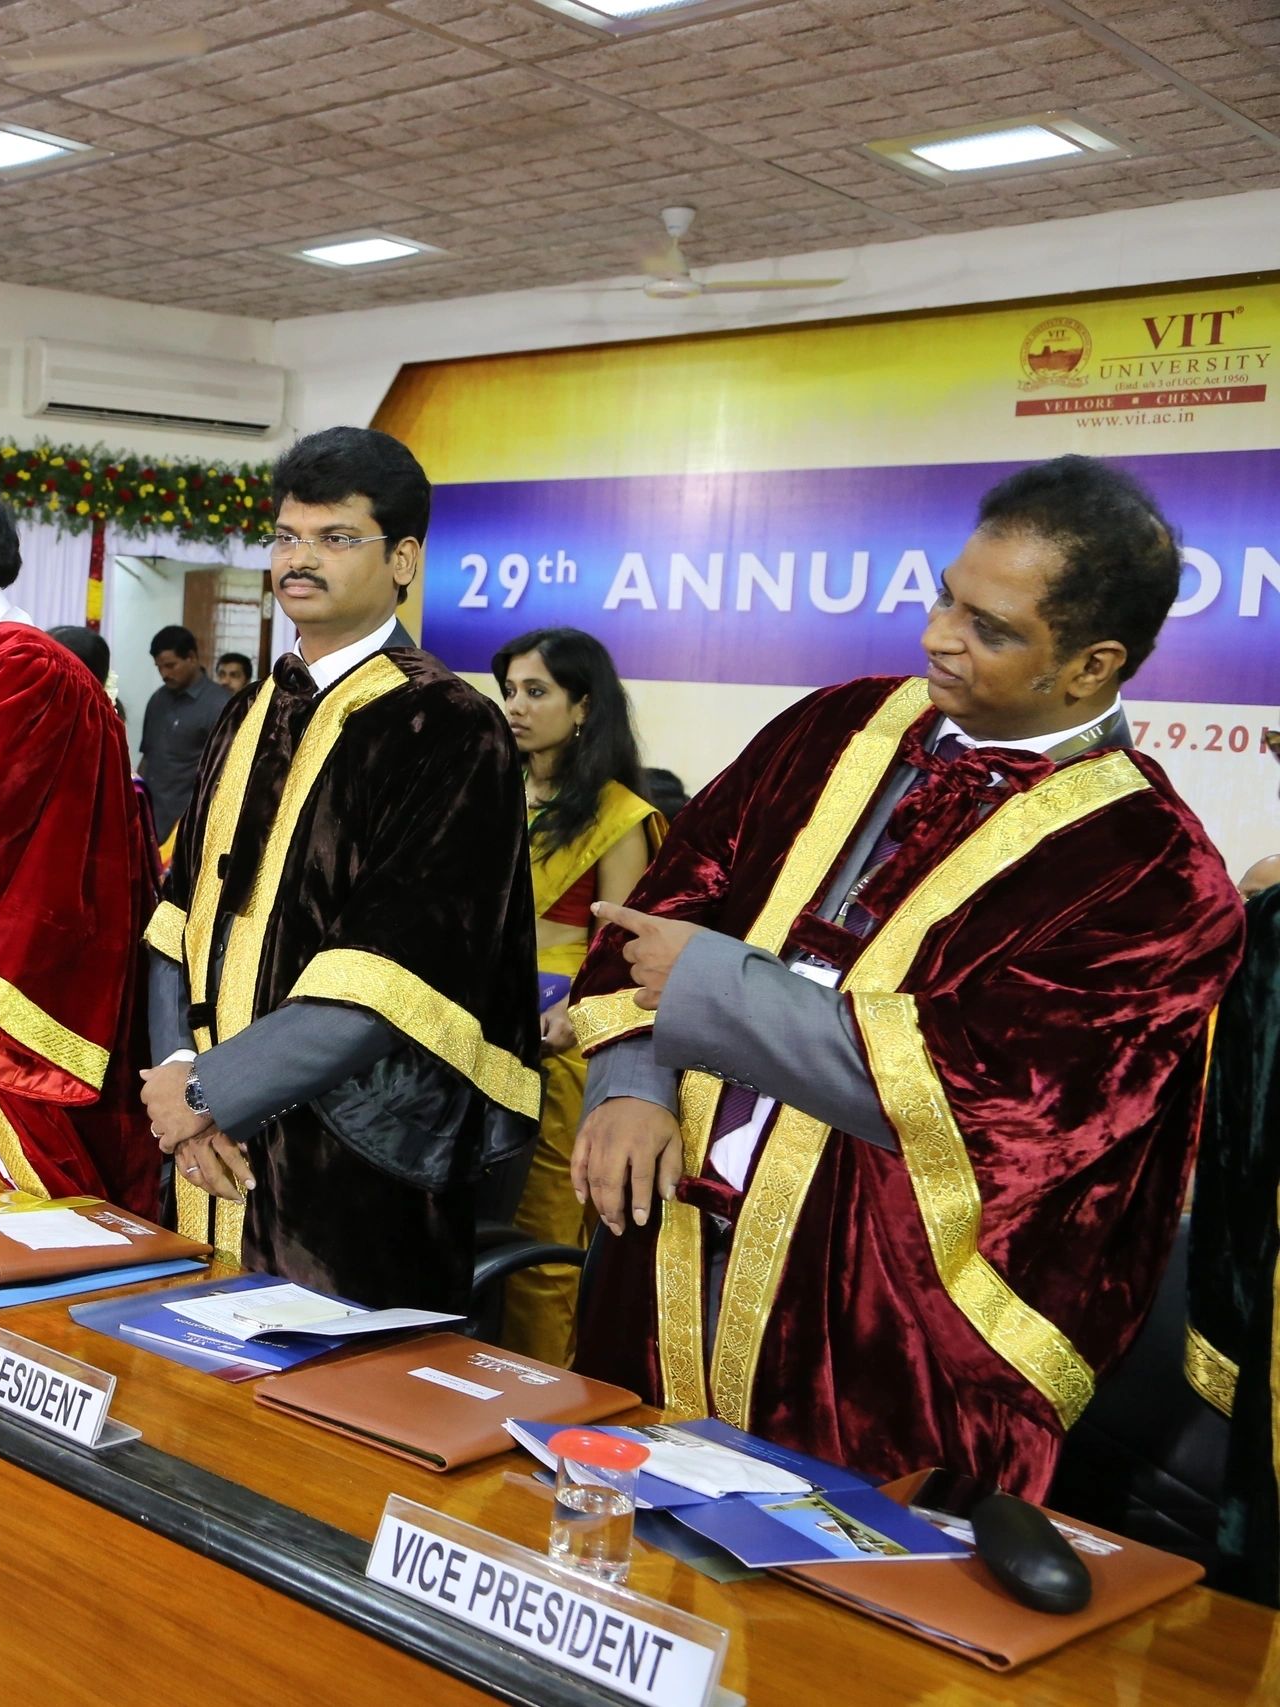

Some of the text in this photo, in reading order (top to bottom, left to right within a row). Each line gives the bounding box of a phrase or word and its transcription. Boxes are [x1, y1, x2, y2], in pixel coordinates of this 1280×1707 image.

[1099, 353, 1271, 379] UNIVERSITY
[1165, 377, 1176, 388] of
[1177, 376, 1201, 387] UGC
[1203, 376, 1220, 386] Act
[1223, 373, 1249, 385] 1956)
[1044, 390, 1232, 412] VELLORE CHENNAI
[1076, 408, 1195, 429] www.vit.ac.in
[458, 546, 1280, 618] 29th ANNUA ON
[1078, 723, 1105, 743] VIT
[850, 876, 870, 896] VIT
[390, 1526, 674, 1692] VICE PRESIDENT
